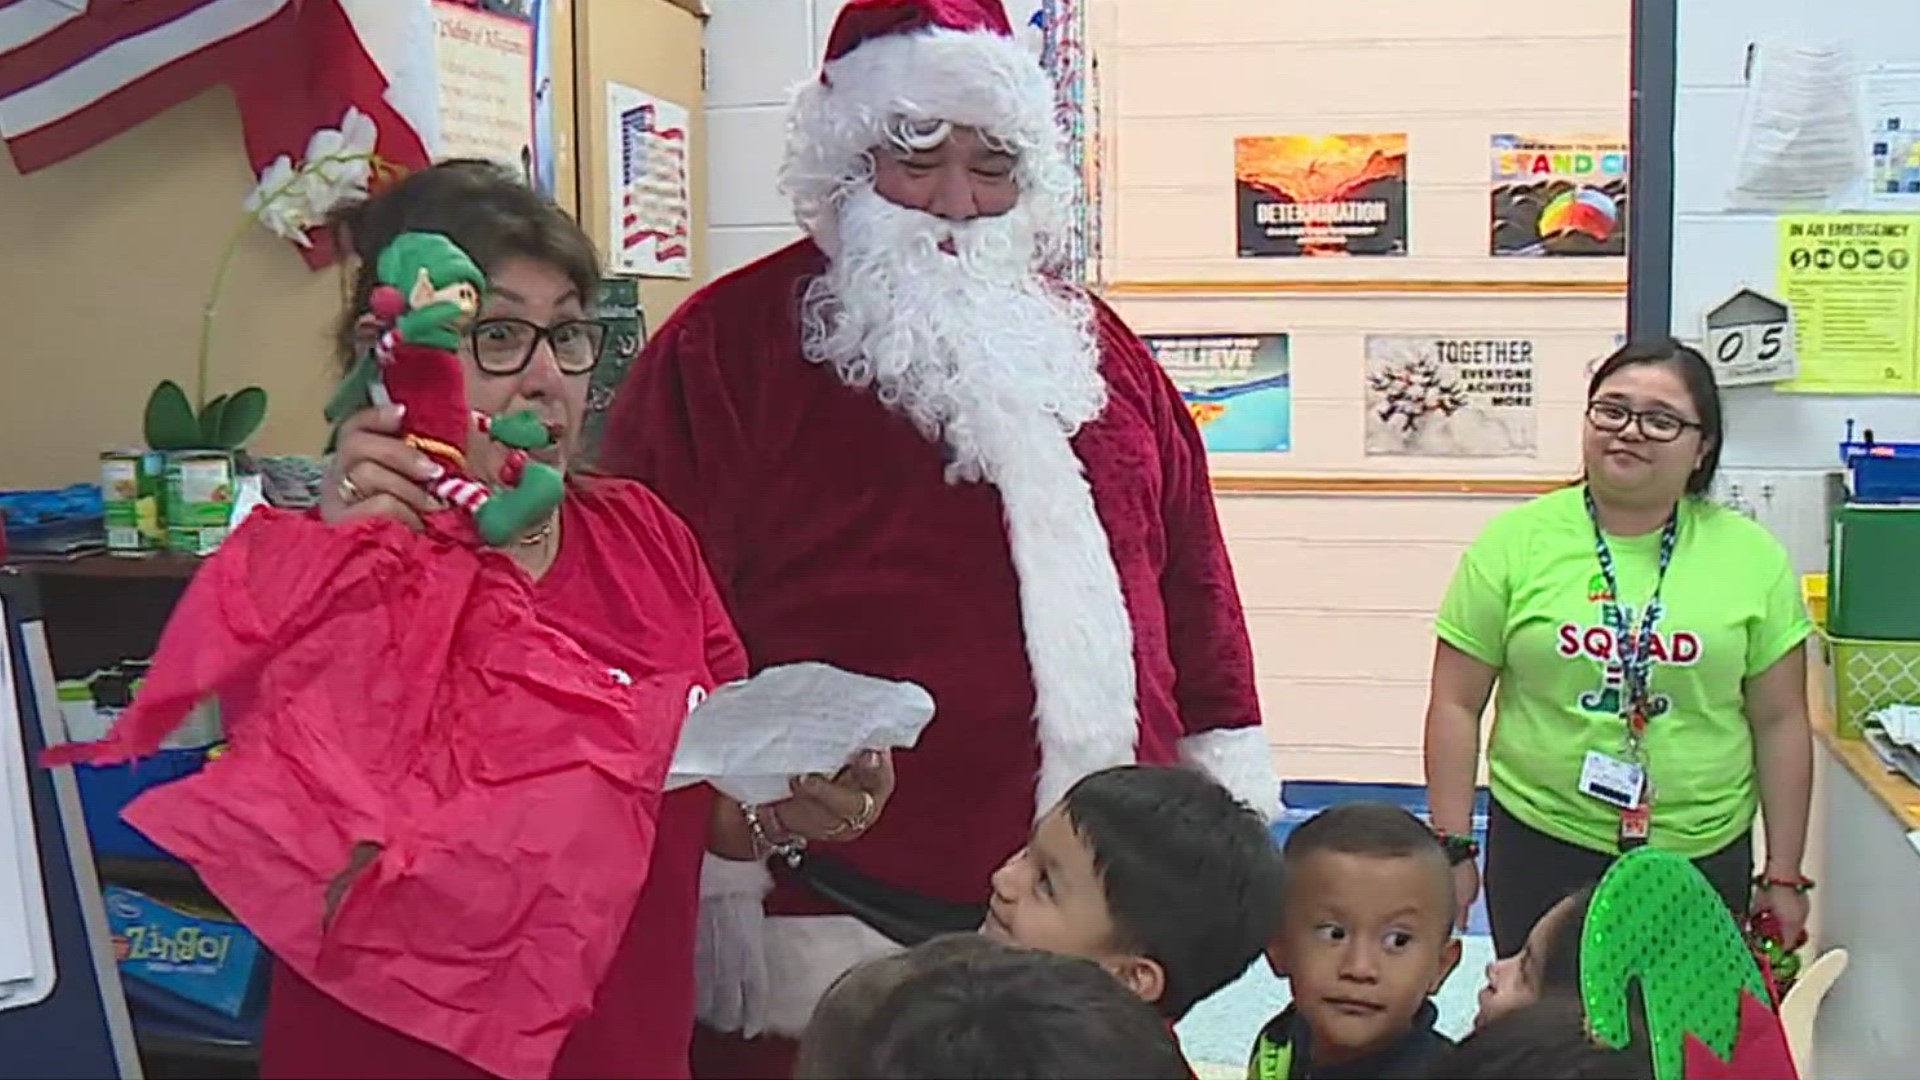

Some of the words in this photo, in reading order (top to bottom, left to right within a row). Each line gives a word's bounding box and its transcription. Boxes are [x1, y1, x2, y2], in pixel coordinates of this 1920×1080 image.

[1501, 153, 1594, 173] STAND
[1256, 202, 1387, 223] DETERMINATION
[1789, 224, 1803, 236] IN
[1828, 224, 1909, 236] EMERGENCY
[1436, 341, 1532, 363] TOGETHER
[1461, 369, 1531, 379] EVERYONE
[1467, 383, 1531, 393] ACHIEVES
[1491, 397, 1531, 406] MORE
[125, 925, 231, 969] Zingo!
